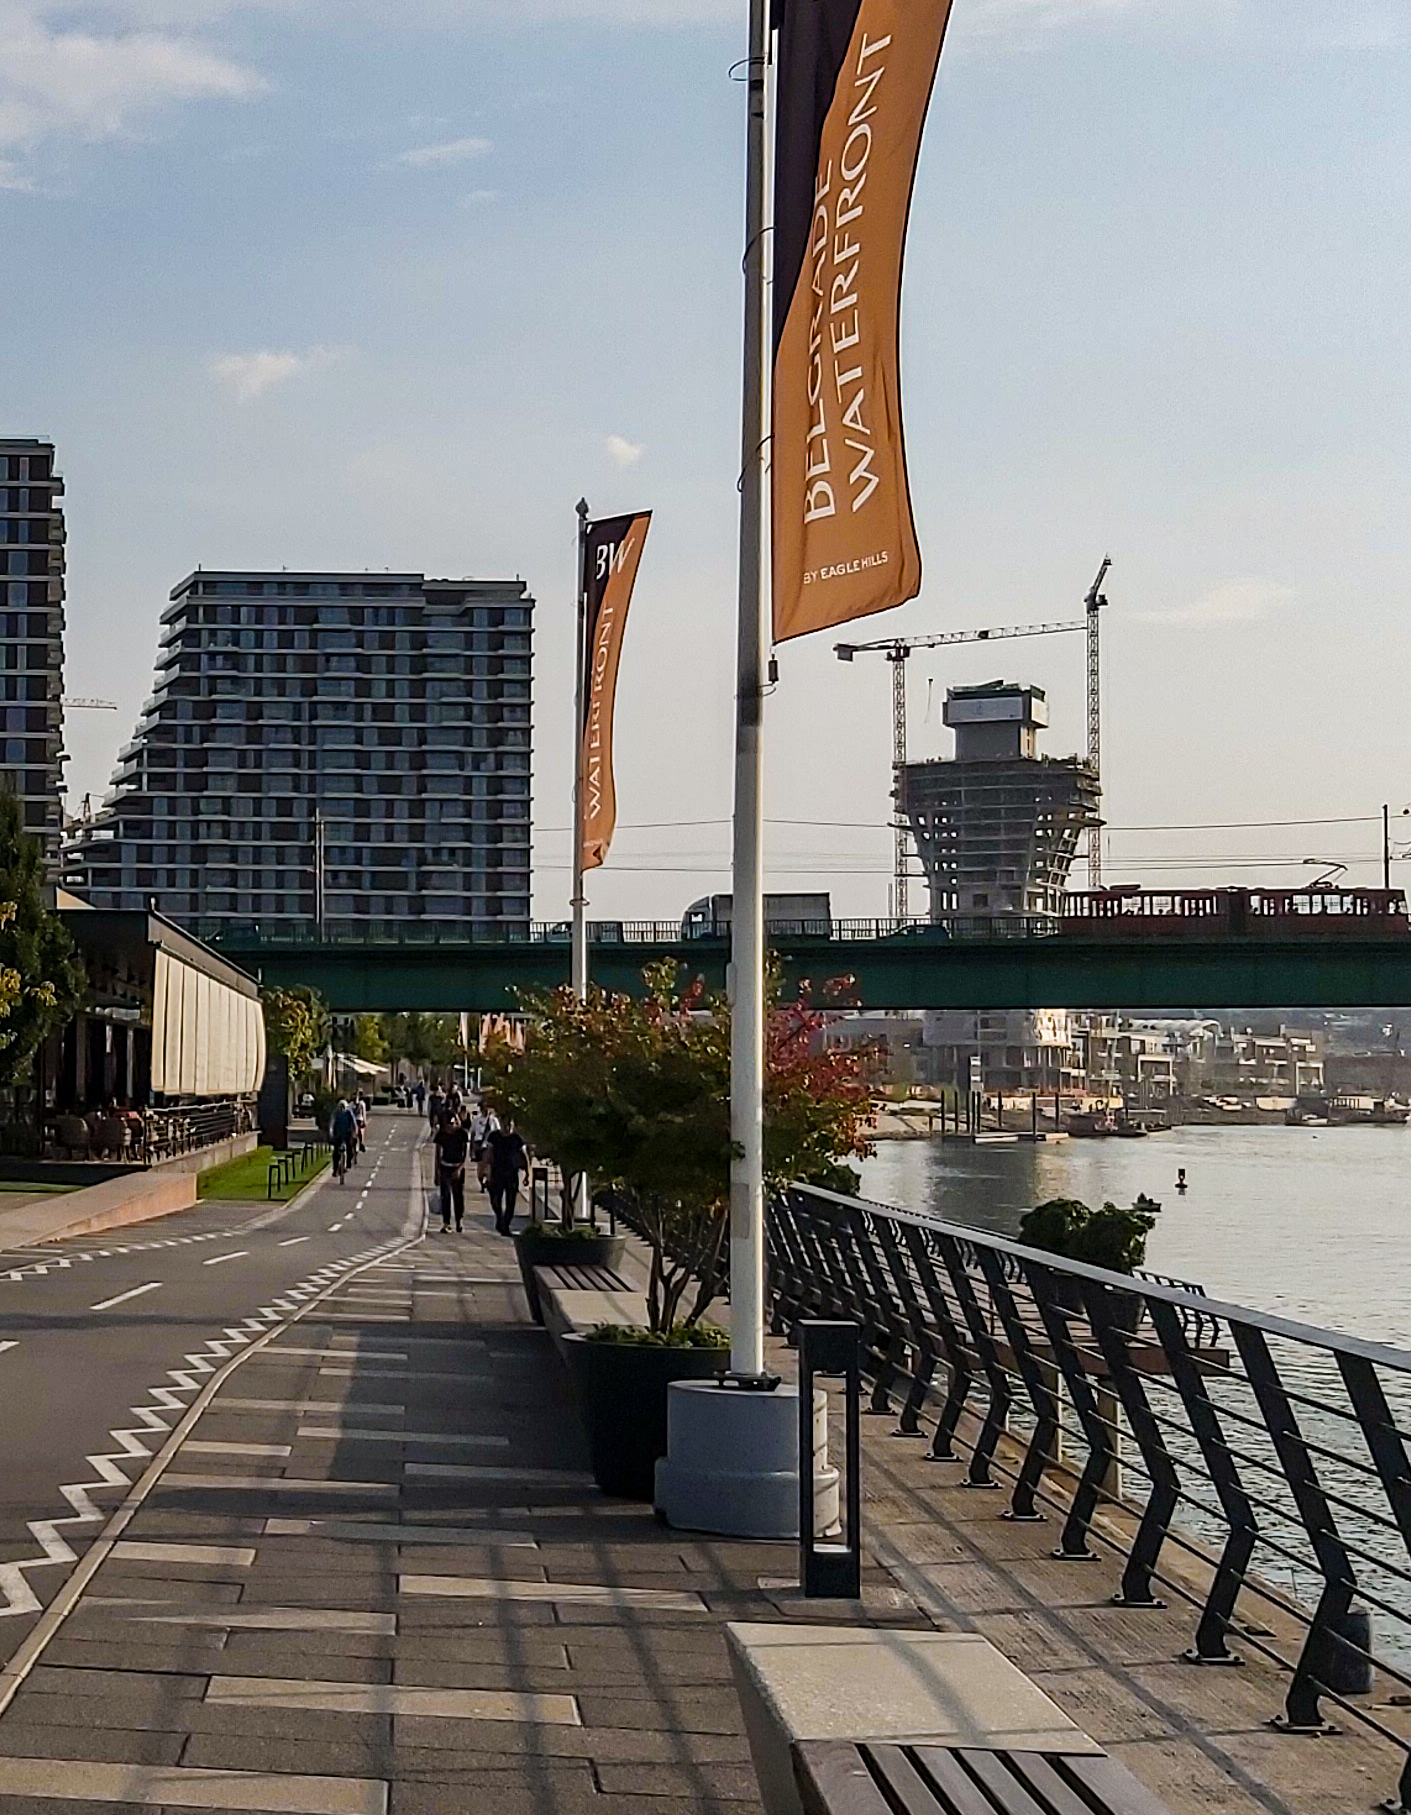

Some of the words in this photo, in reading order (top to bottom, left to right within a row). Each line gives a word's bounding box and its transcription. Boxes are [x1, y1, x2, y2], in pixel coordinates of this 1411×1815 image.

[803, 158, 836, 525] BELGRADE
[829, 33, 892, 514] WATERFRONT
[595, 537, 636, 580] BW
[803, 569, 819, 585] BY
[819, 559, 861, 580] EAGLE
[861, 550, 889, 569] HILLS
